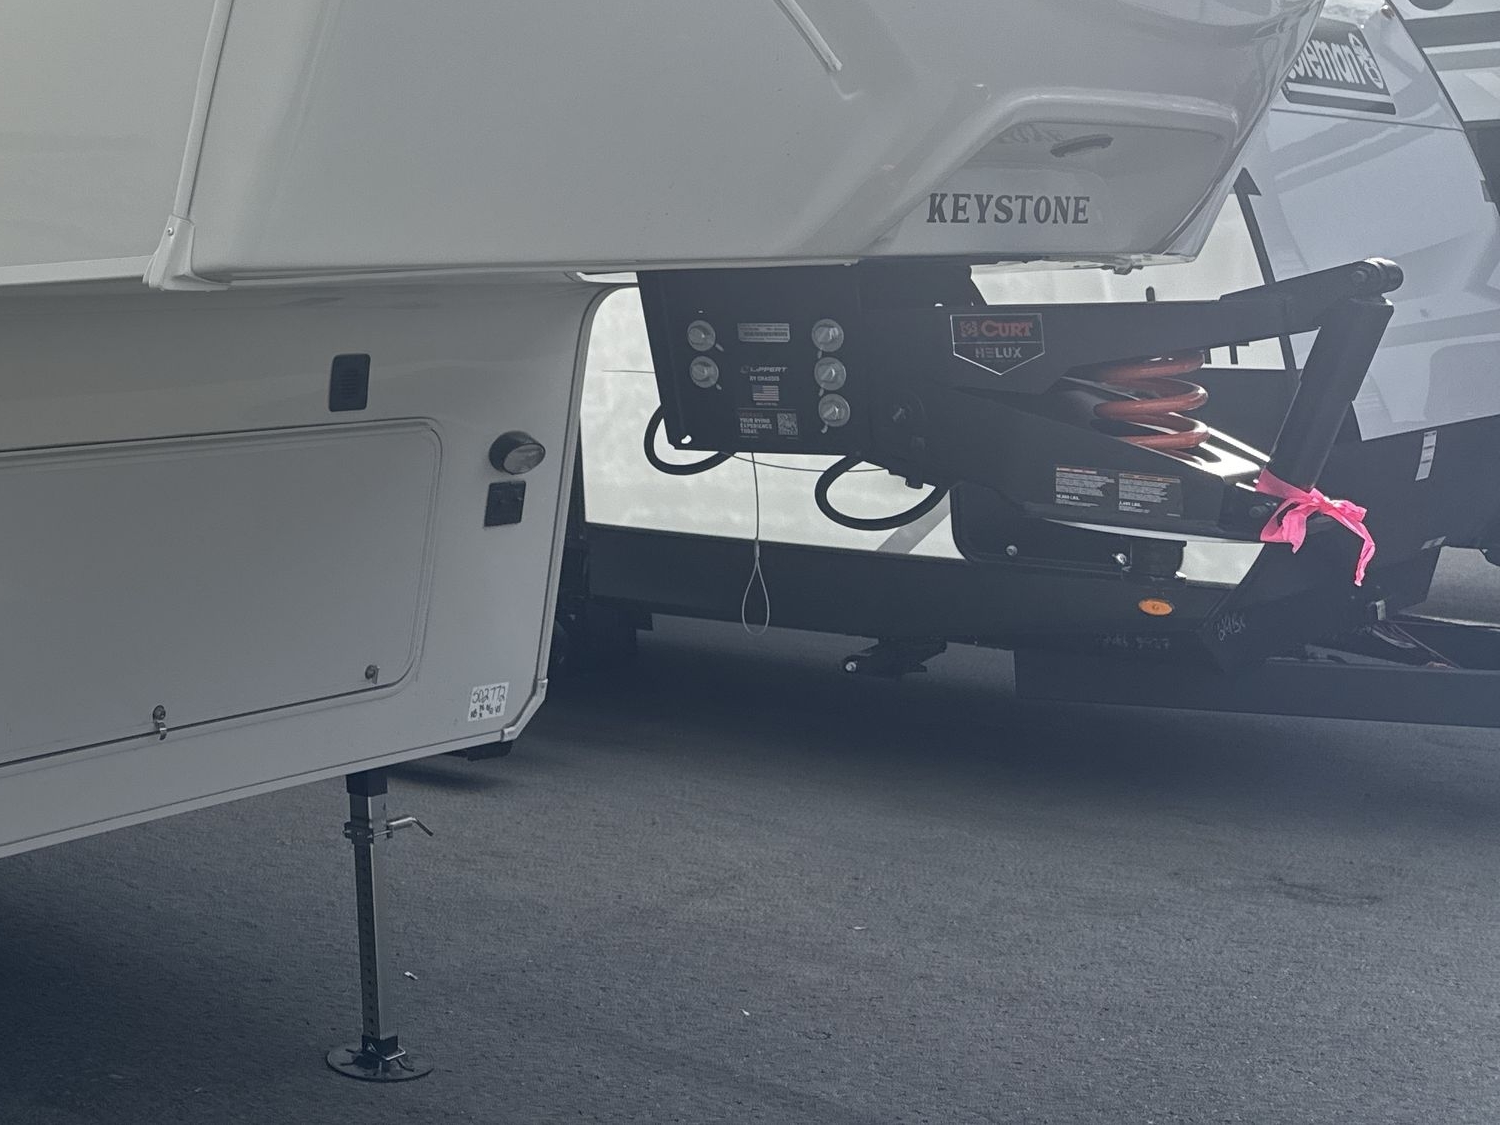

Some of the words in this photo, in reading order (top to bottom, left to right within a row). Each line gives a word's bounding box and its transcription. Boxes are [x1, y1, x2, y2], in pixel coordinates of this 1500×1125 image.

[926, 193, 1090, 224] KEYSTONE
[981, 320, 1033, 337] CURT
[975, 346, 1022, 359] HELUX
